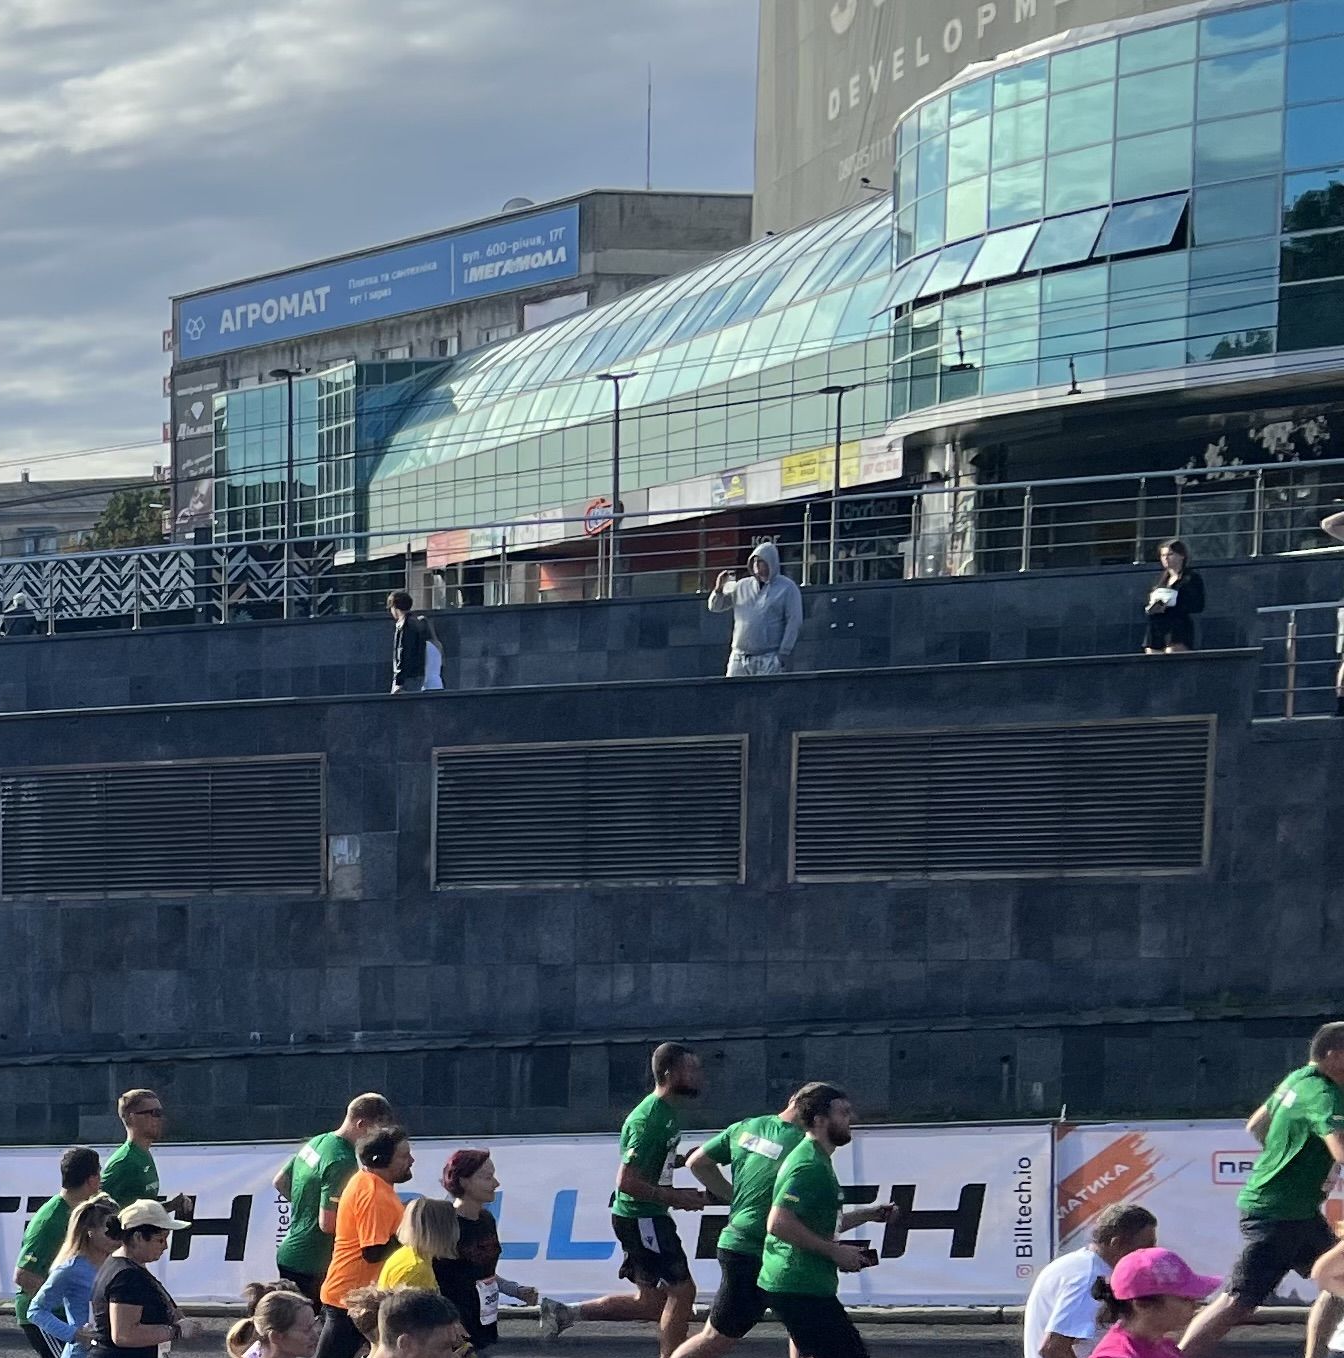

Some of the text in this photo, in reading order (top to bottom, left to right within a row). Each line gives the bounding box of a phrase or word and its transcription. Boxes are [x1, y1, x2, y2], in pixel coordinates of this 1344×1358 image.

[827, 0, 1069, 121] DEVELOPM
[219, 284, 332, 335] АГРОМАТ
[1013, 1156, 1033, 1259] Billtech.io
